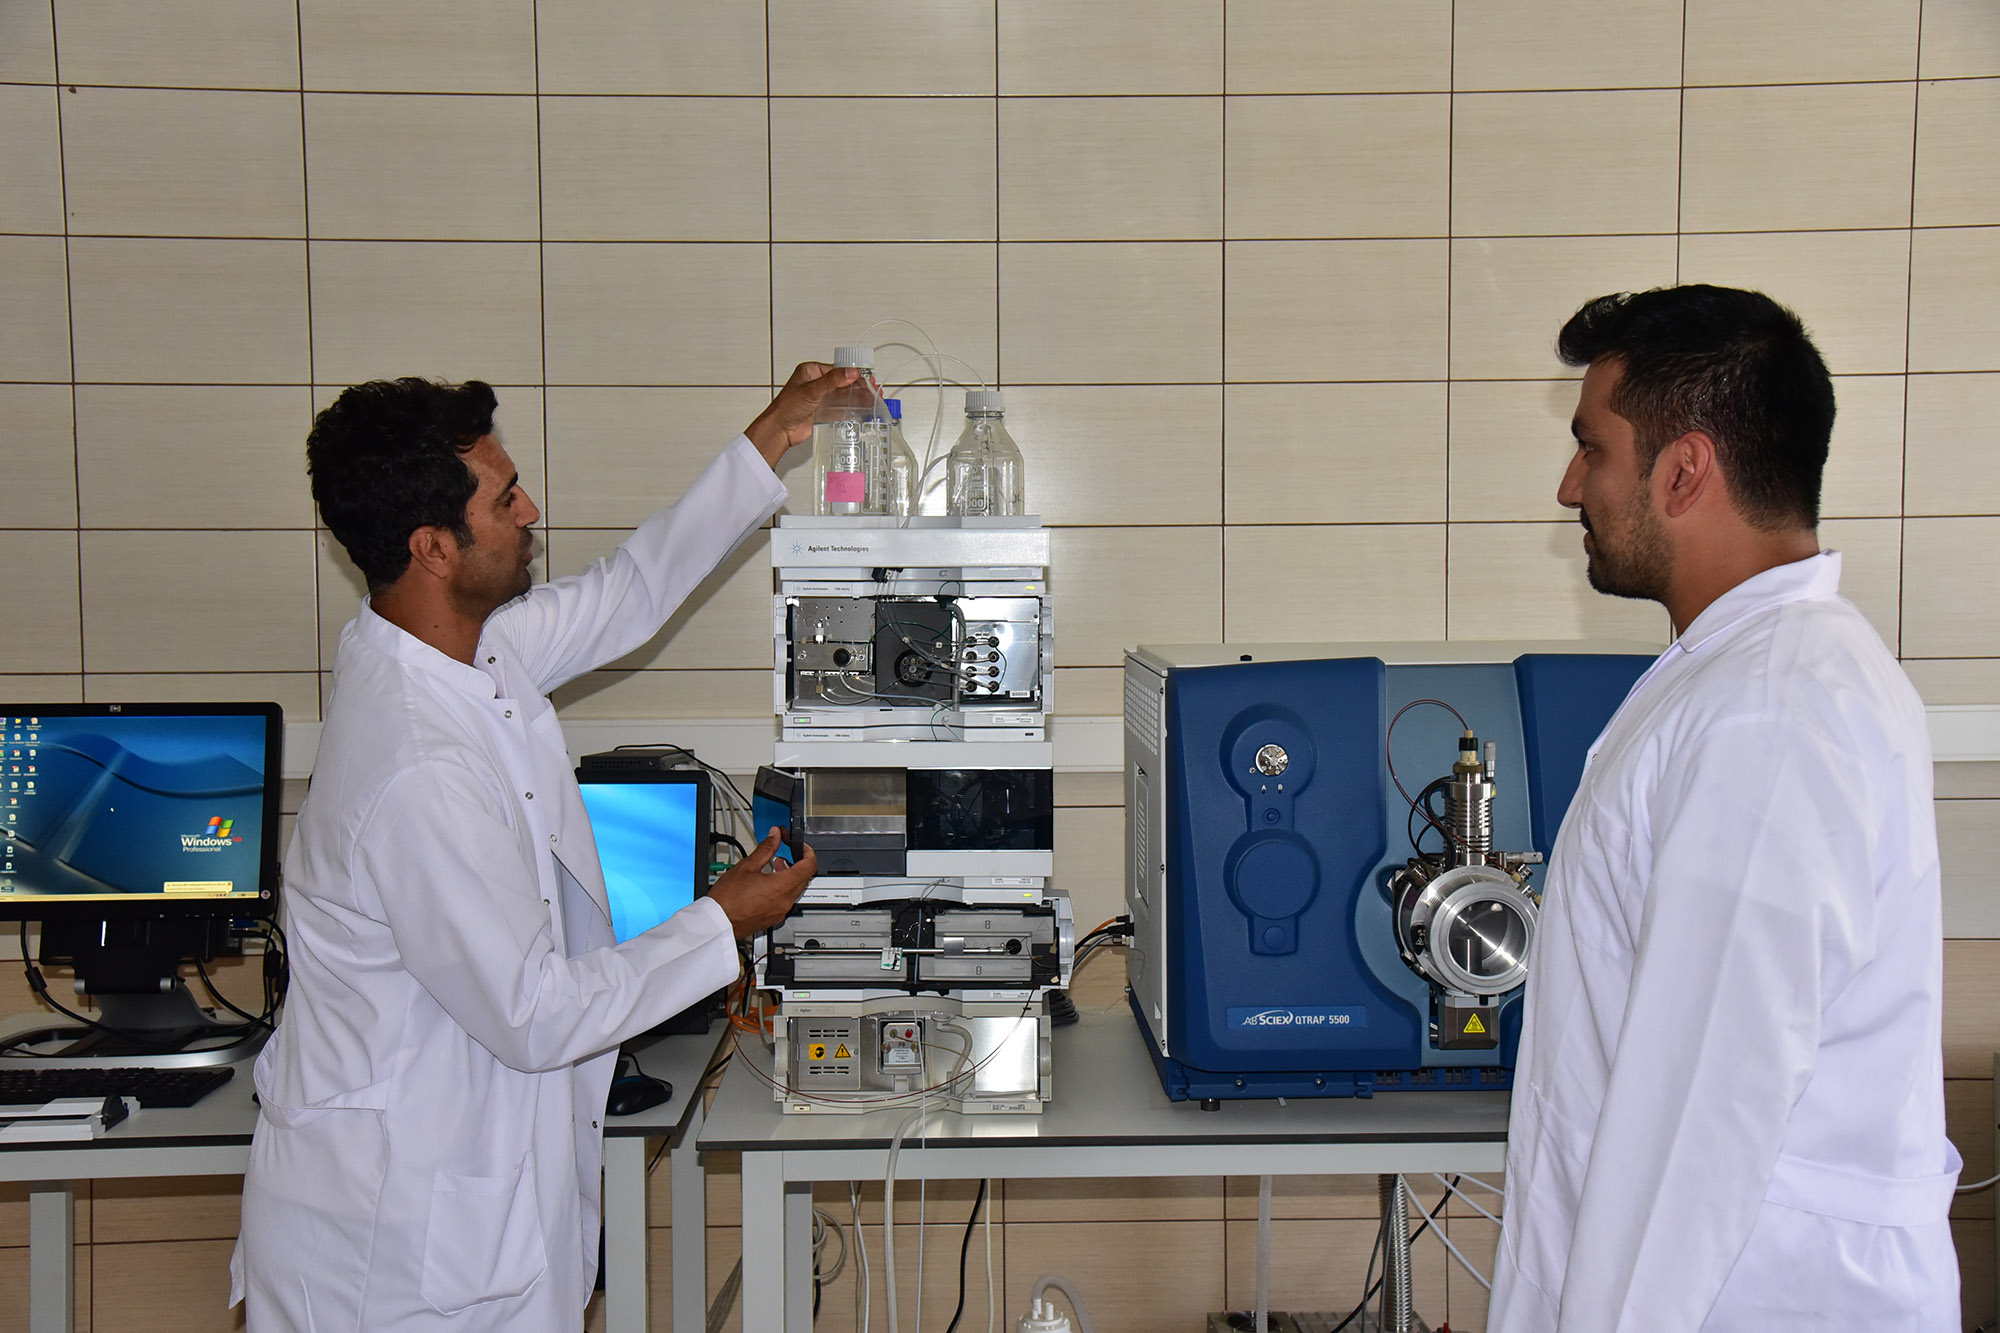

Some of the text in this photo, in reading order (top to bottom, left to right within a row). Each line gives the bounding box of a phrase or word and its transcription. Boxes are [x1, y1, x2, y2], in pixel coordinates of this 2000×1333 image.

[807, 545, 869, 553] Agilent Technologies
[181, 837, 232, 847] Windows
[1241, 1014, 1350, 1026] AB SCIEX QTRAP 5500
